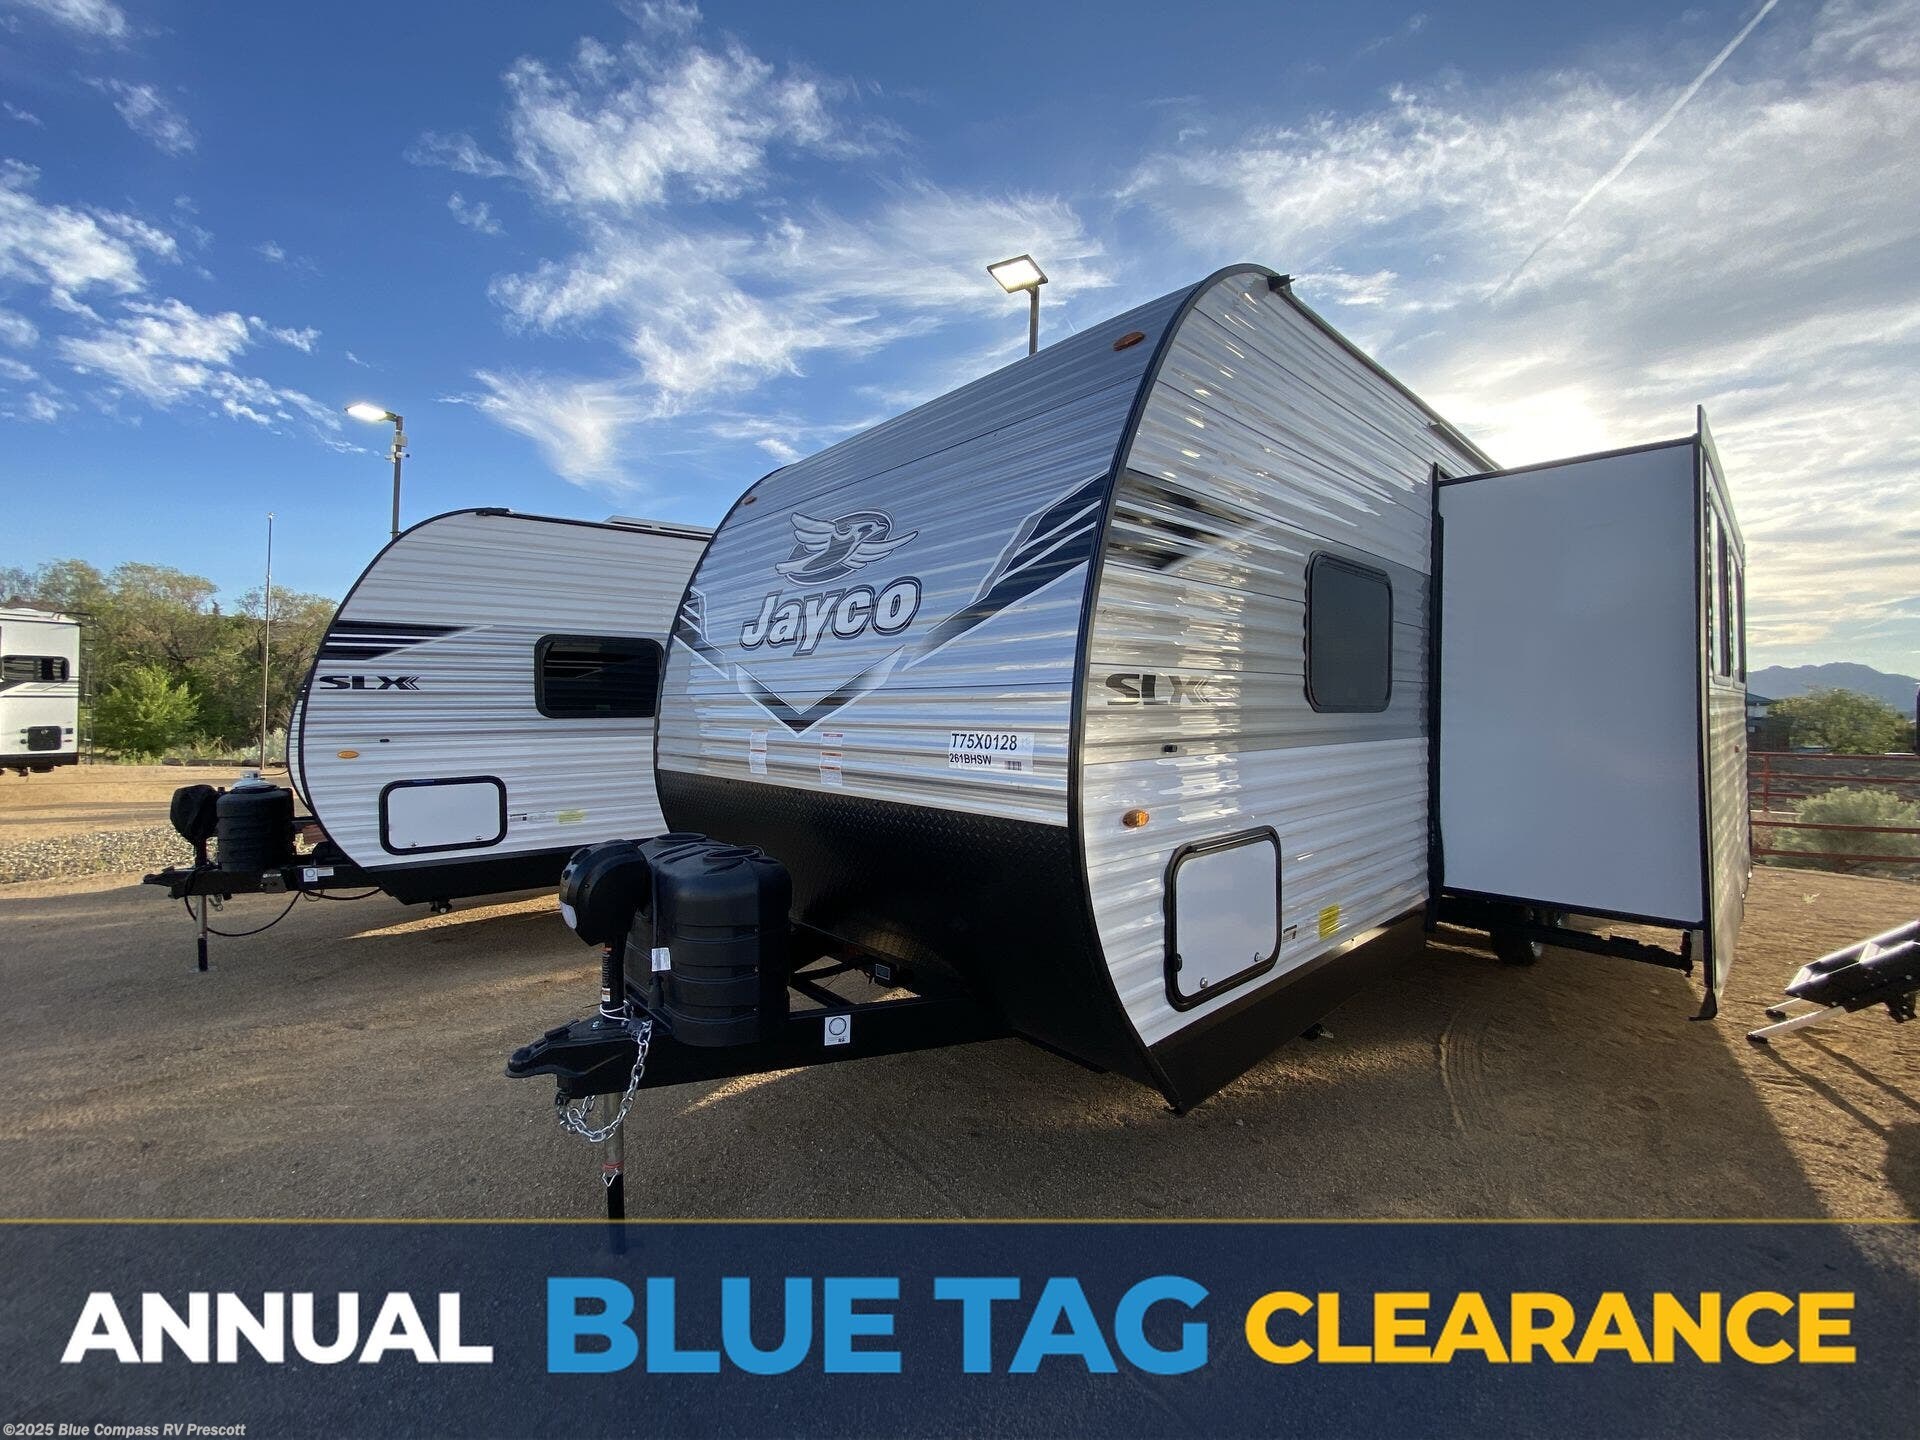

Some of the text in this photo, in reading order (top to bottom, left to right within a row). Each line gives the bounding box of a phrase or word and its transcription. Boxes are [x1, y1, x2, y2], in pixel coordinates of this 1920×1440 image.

[739, 576, 922, 656] Jayco
[319, 676, 420, 690] SLX
[952, 733, 1018, 751] T75X0128
[949, 753, 992, 765] 261BHSW
